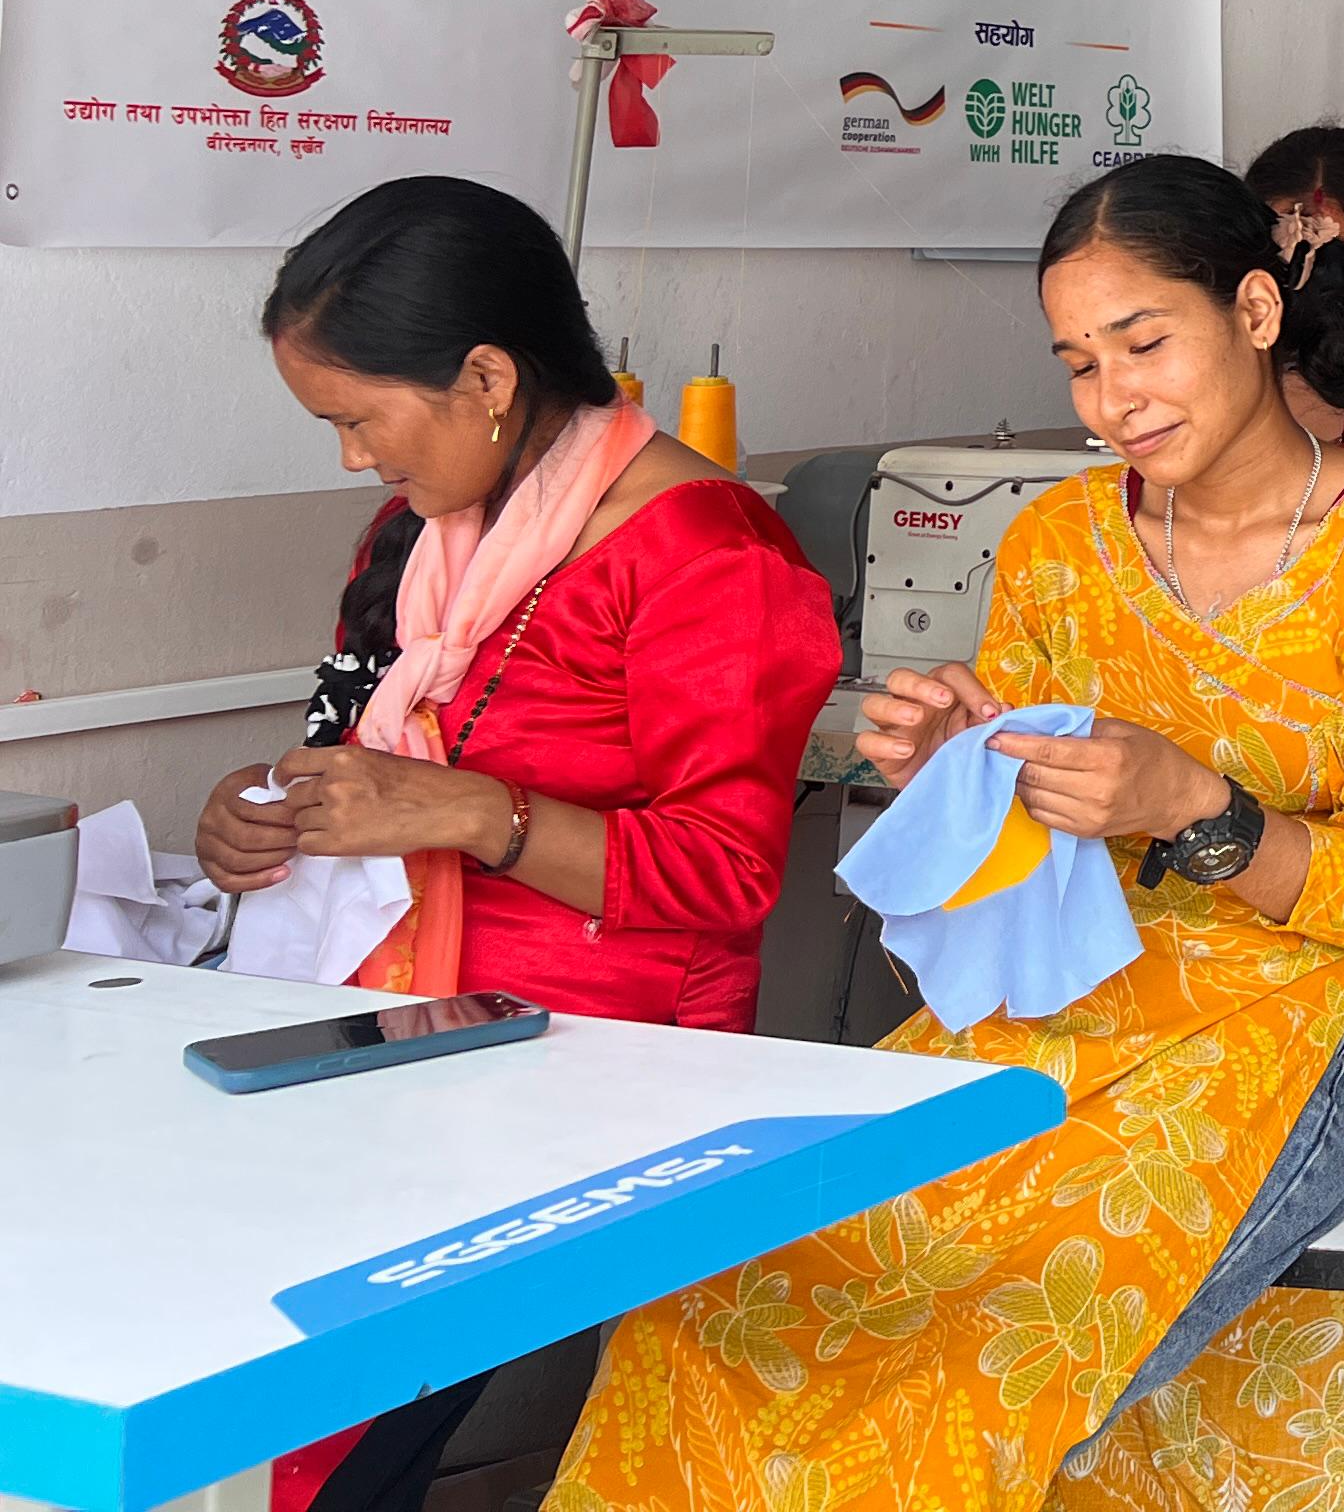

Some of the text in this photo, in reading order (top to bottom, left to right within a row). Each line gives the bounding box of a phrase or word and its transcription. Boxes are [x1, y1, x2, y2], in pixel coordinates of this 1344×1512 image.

[974, 19, 1035, 49] सहयोग
[1011, 81, 1056, 109] WELT
[63, 96, 452, 136] उद्योग तथा उपभोक्ता हित संरक्षण निर्देशनालय
[842, 116, 890, 131] german
[1011, 110, 1082, 139] HUNGER
[841, 131, 896, 143] cooperation
[969, 143, 1000, 163] WHH
[1010, 139, 1060, 166] HILFE
[893, 509, 964, 530] GEMSY
